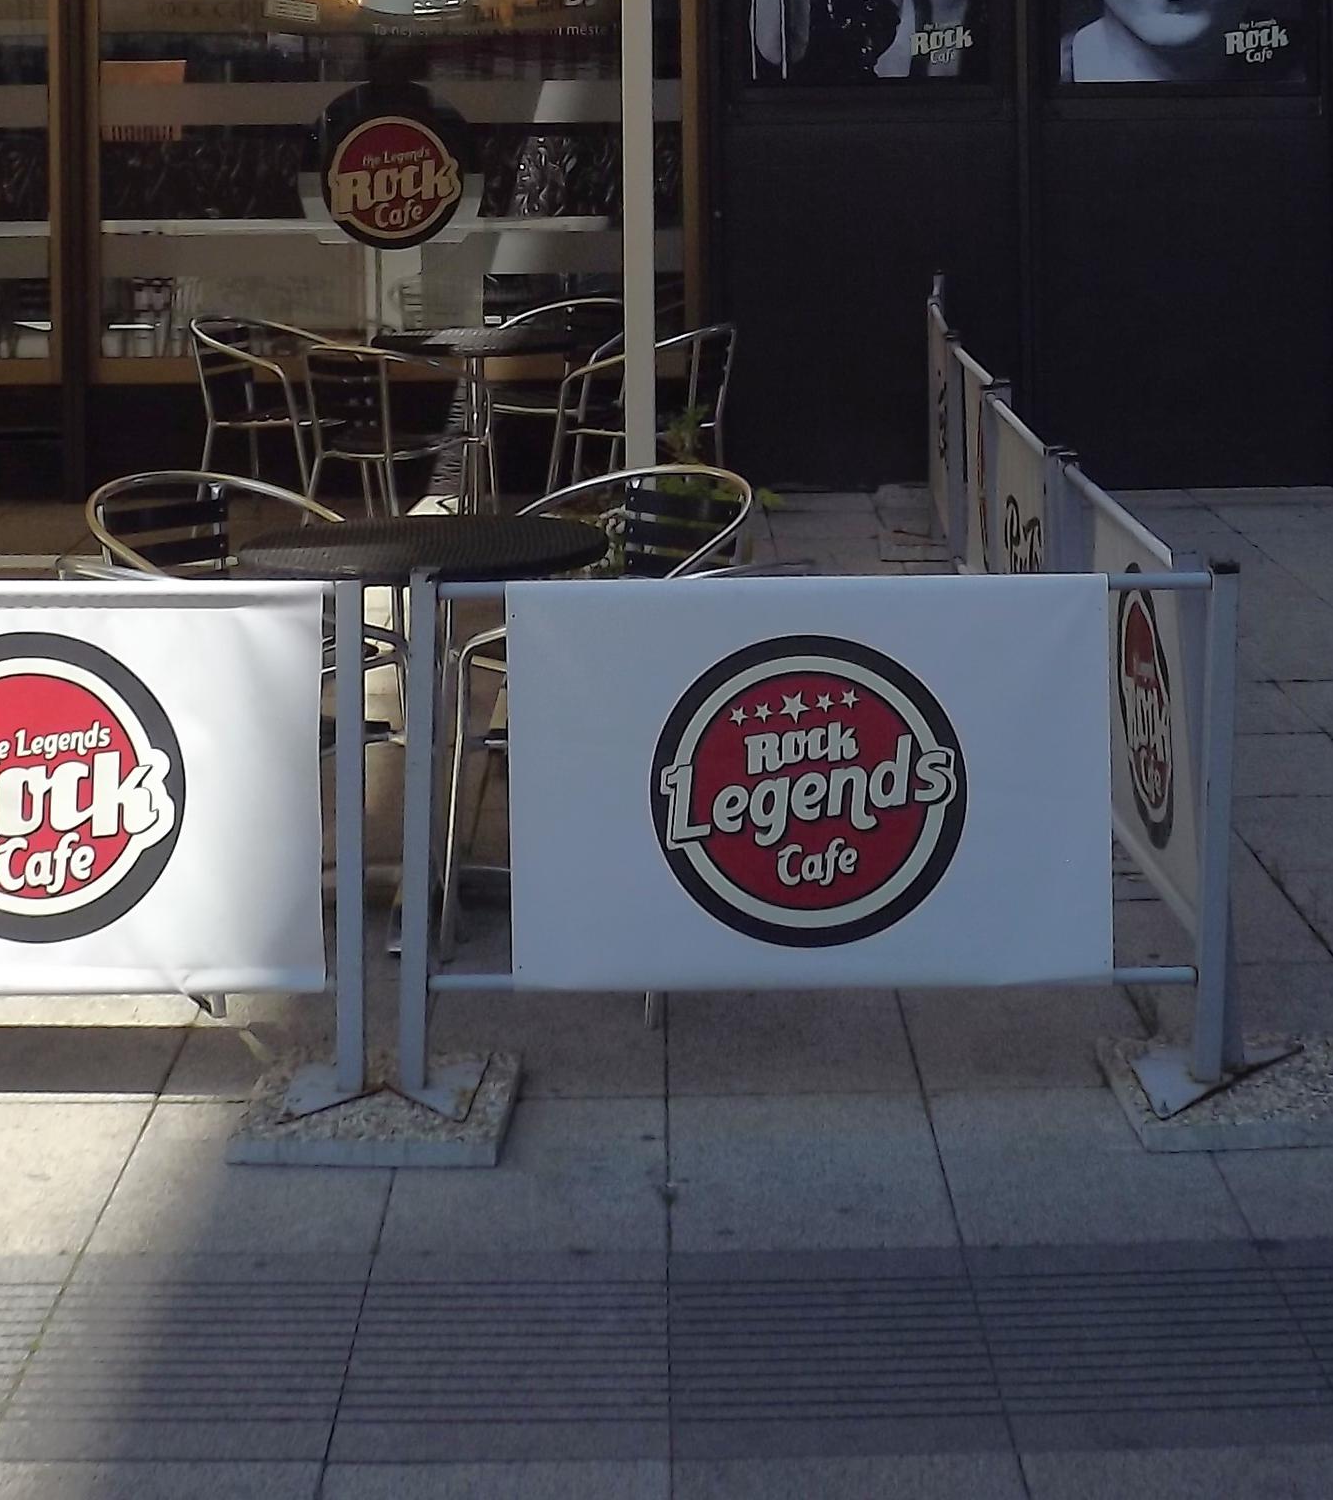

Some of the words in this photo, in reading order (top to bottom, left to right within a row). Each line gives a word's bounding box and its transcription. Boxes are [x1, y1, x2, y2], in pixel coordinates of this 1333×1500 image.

[1246, 46, 1274, 64] Cafe
[373, 198, 424, 228] Cafe
[15, 721, 112, 760] Legends
[665, 733, 951, 847] Legends
[777, 836, 858, 886] Cafe
